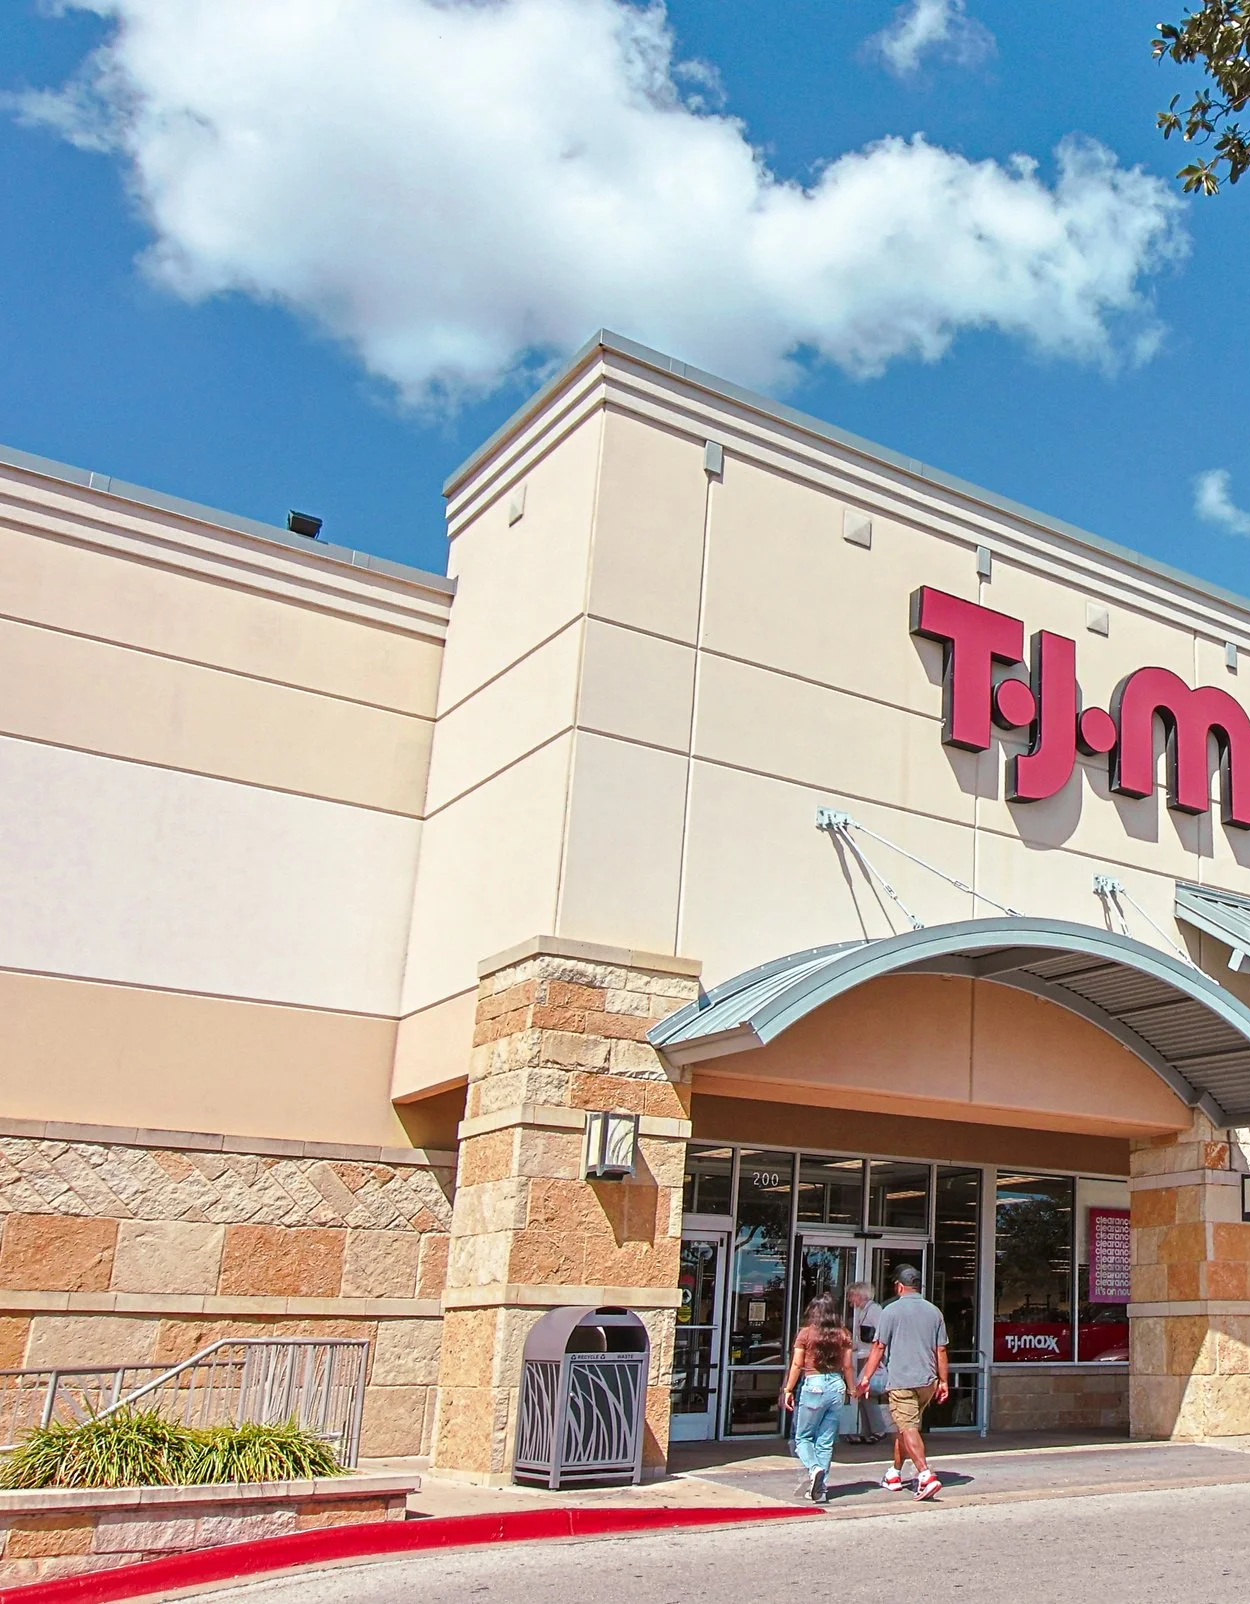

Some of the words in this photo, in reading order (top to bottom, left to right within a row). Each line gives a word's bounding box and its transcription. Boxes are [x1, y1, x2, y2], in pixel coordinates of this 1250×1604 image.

[752, 1172, 779, 1187] 200
[1095, 1216, 1130, 1225] clearanc
[1095, 1224, 1130, 1233] clearanc
[1095, 1231, 1130, 1240] clearanc
[1095, 1240, 1130, 1248] clearanc
[1095, 1247, 1130, 1256] clearanc
[1095, 1254, 1130, 1264] clearanc
[1095, 1262, 1130, 1271] clearanc
[1095, 1270, 1130, 1279] clearanc
[1095, 1278, 1130, 1287] clearanc
